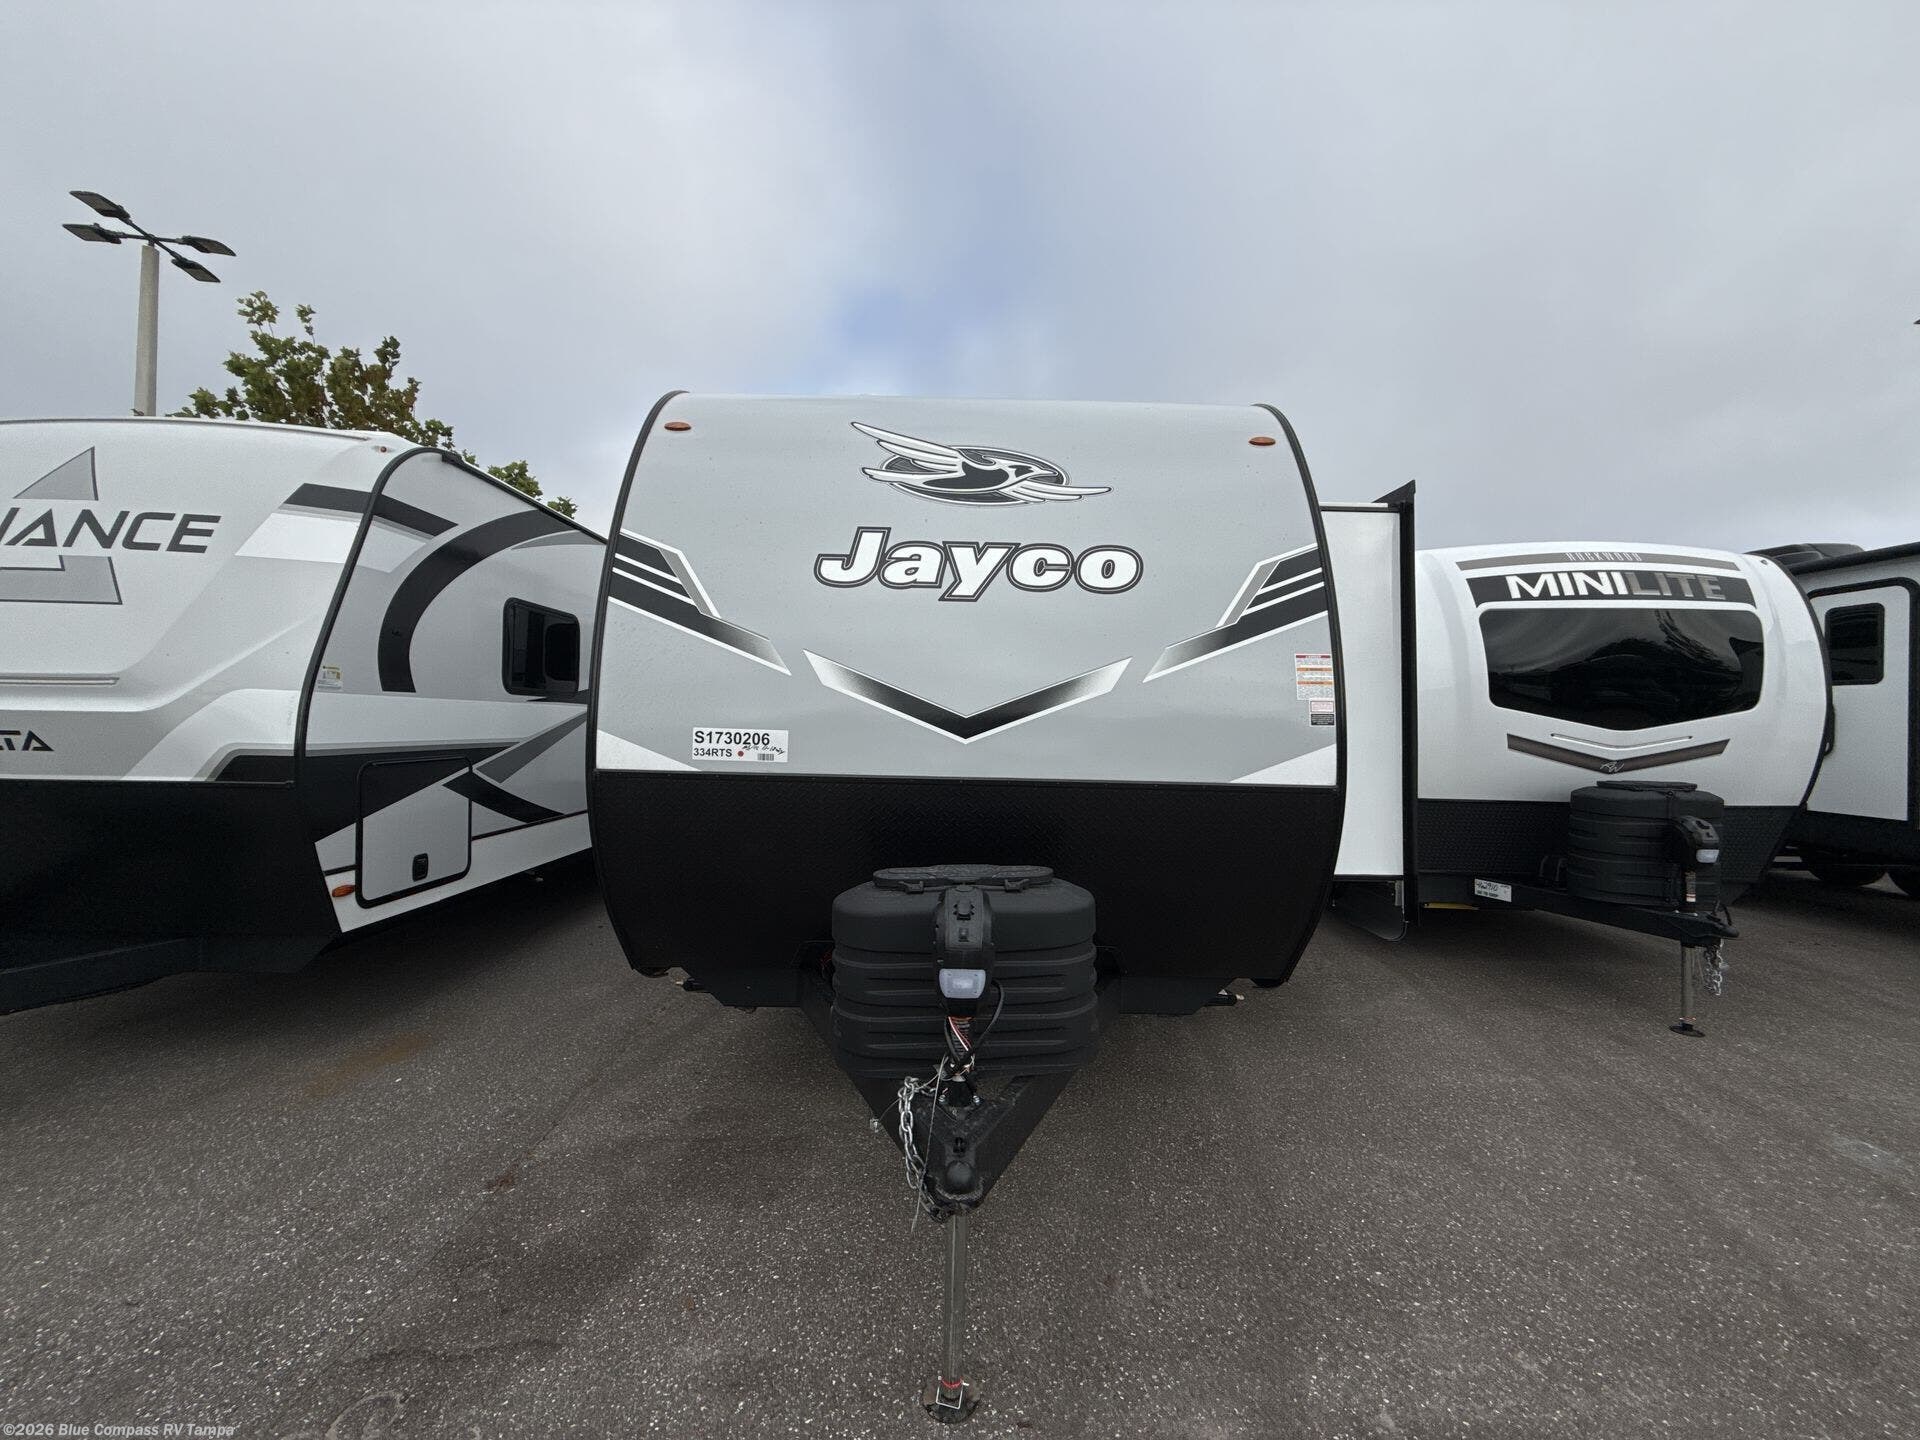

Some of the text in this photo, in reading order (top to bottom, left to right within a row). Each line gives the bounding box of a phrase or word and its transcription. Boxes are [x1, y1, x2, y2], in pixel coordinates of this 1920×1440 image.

[813, 526, 1144, 602] Jayco
[0, 730, 54, 751] TA
[694, 730, 770, 746] S1730206
[693, 748, 733, 758] 334RTS
